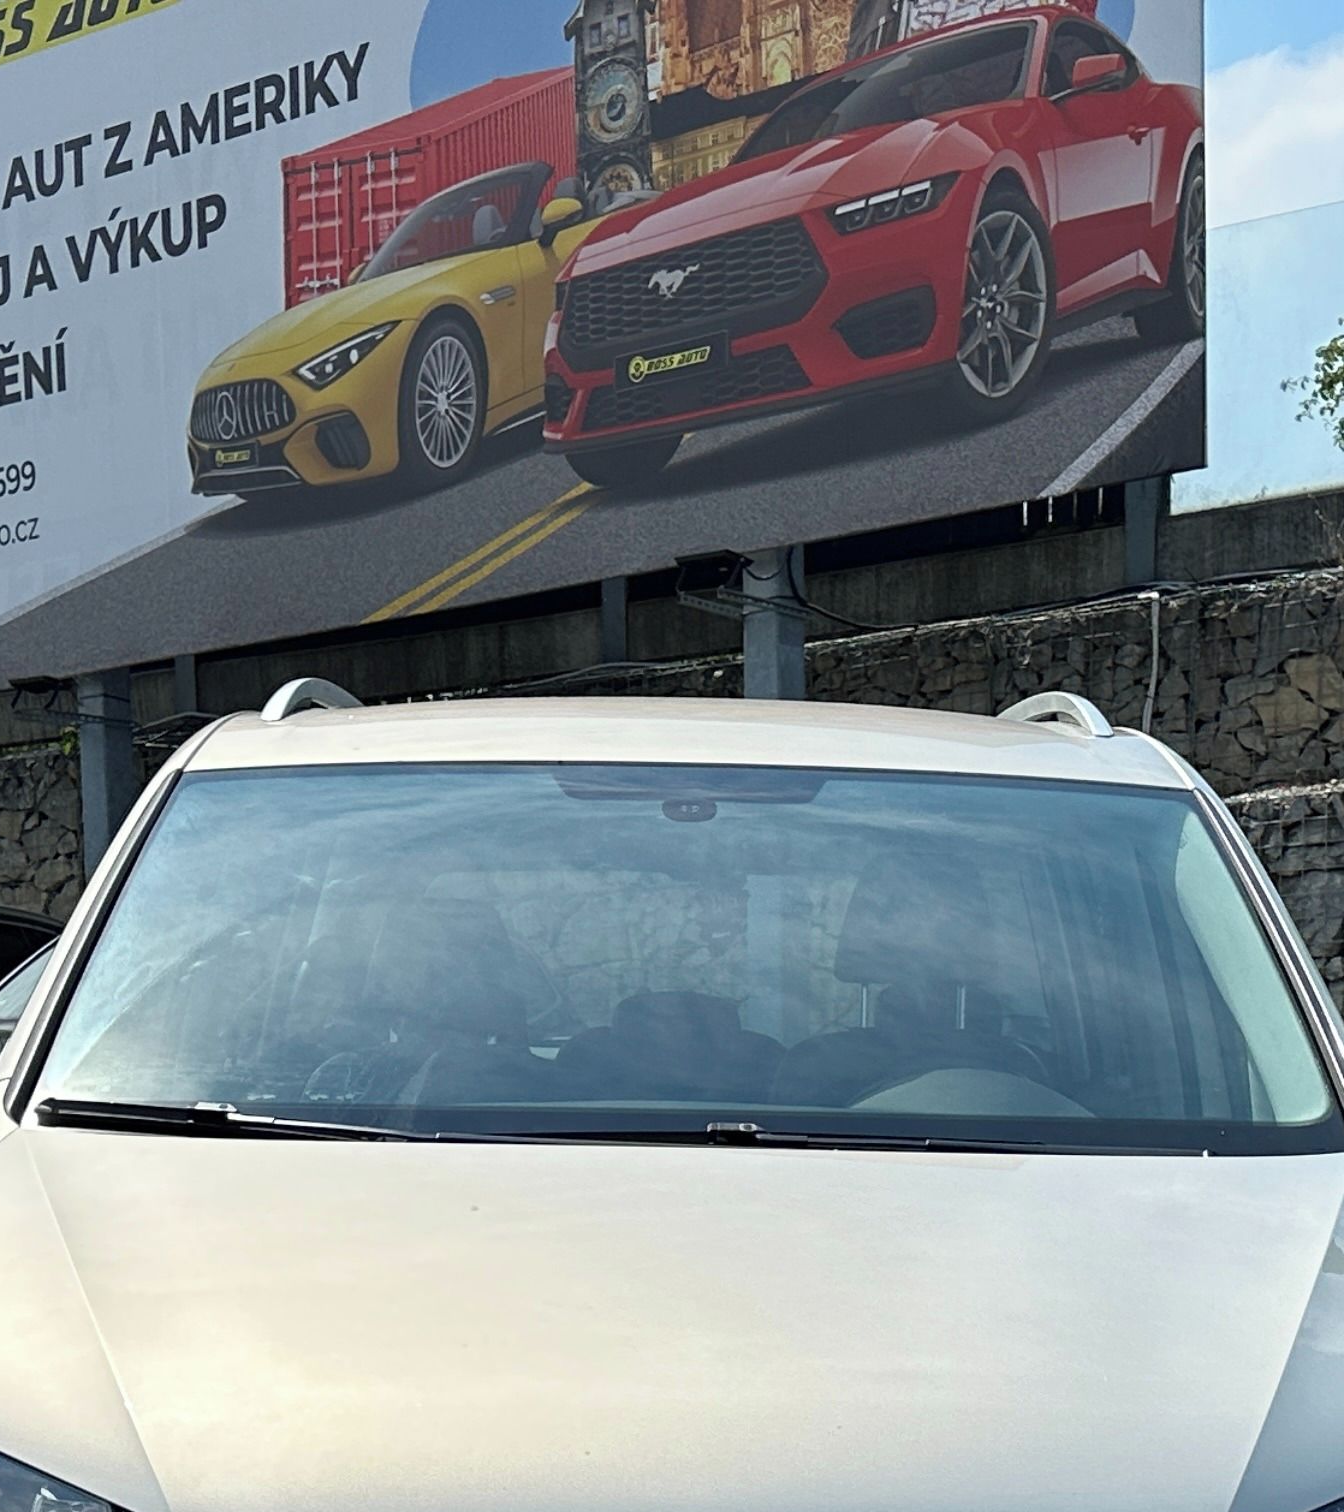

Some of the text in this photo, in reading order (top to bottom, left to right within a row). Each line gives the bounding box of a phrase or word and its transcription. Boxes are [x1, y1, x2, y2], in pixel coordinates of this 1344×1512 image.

[2, 134, 92, 210] AUT
[104, 121, 133, 178] Z
[143, 42, 371, 166] AMERIKY
[23, 244, 58, 298] A
[65, 193, 227, 283] VÝKUP
